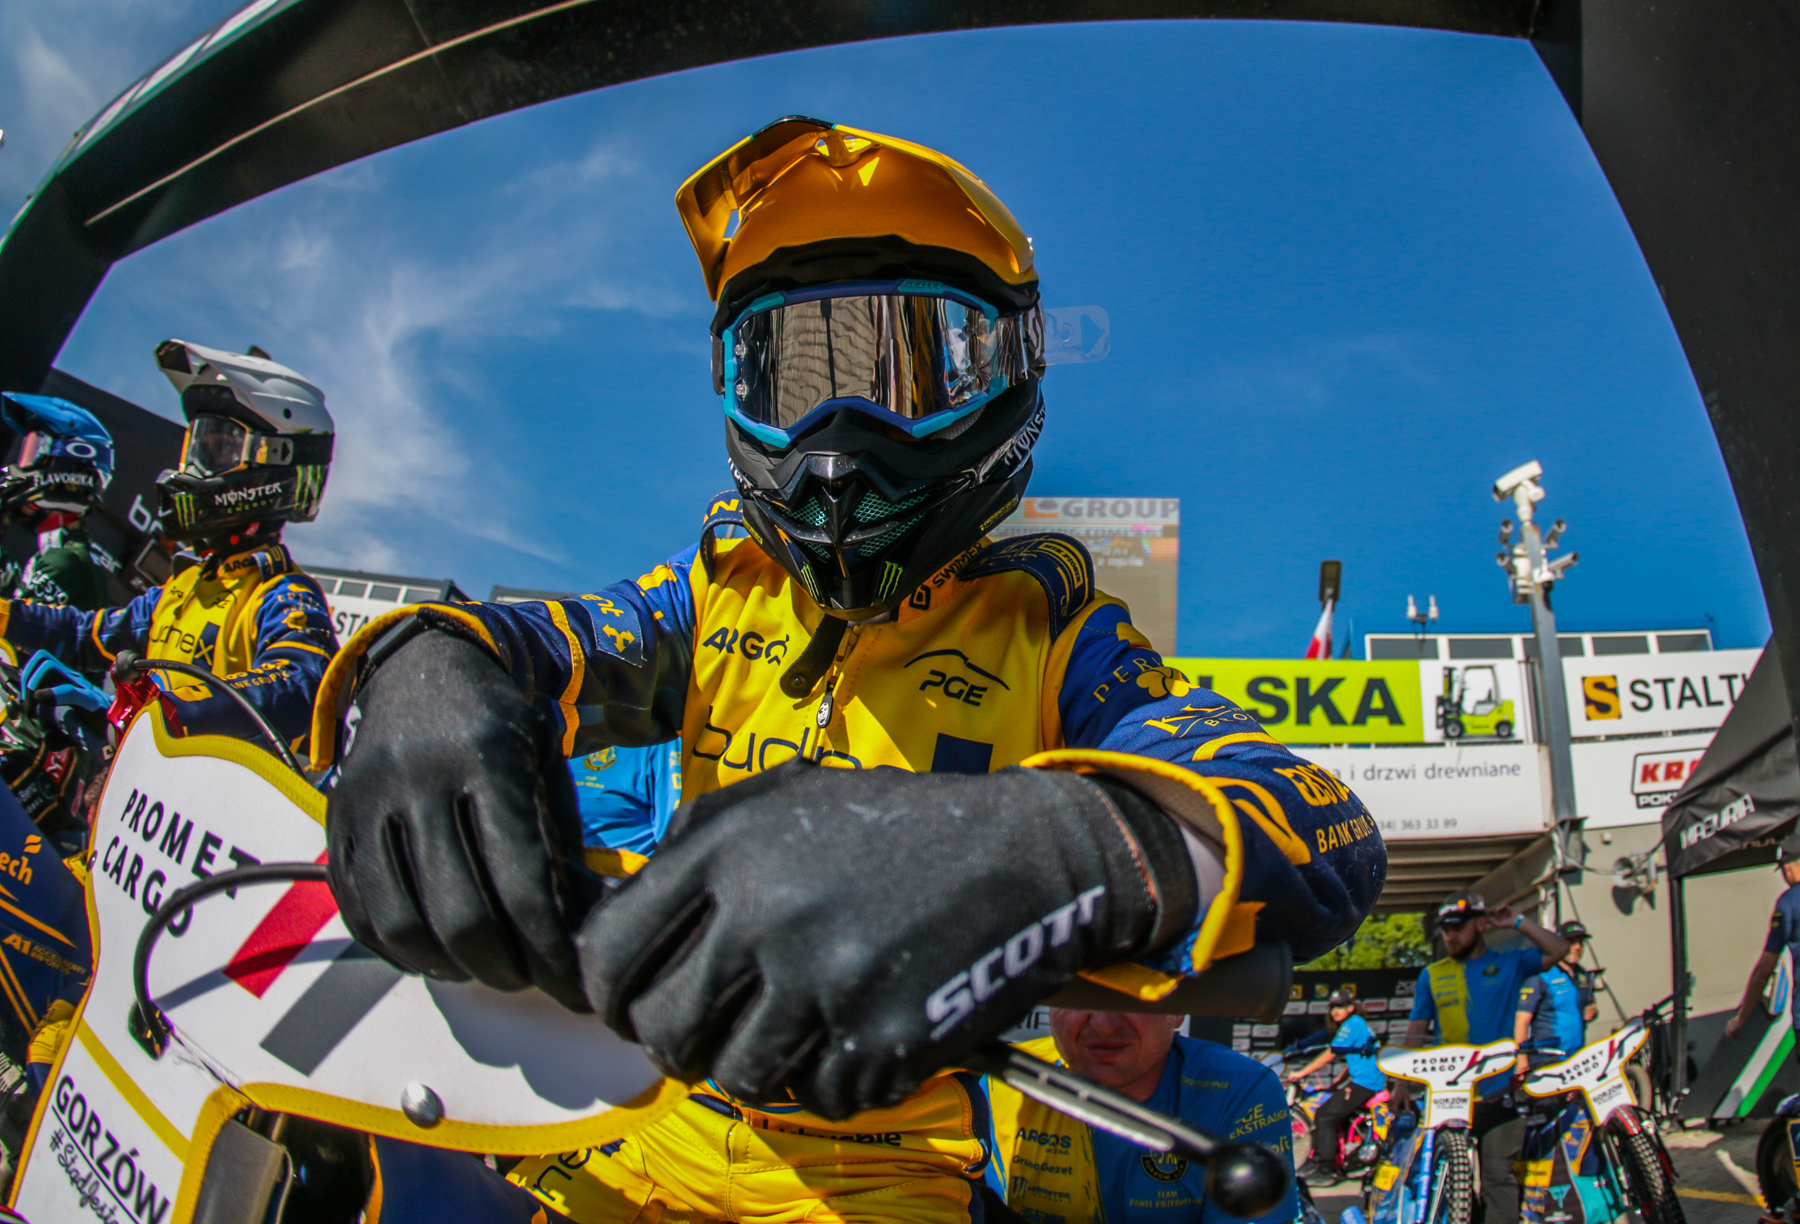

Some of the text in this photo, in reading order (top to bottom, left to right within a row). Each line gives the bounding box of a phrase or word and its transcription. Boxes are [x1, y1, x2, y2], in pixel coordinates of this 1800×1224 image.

[214, 482, 283, 507] MONSTER
[1062, 499, 1179, 519] GROUP
[919, 669, 988, 707] PGE
[1197, 675, 1405, 727] SKA
[1363, 763, 1417, 782] drzwi
[1424, 761, 1522, 781] drewniane
[1640, 759, 1704, 785] KR
[1638, 792, 1678, 807] POK
[926, 884, 1106, 1041] SCOTT
[1412, 1055, 1467, 1065] PROMET
[1412, 1064, 1457, 1074] CARGO
[56, 1074, 171, 1224] GORZÓW
[1015, 1127, 1072, 1149] ARGOS
